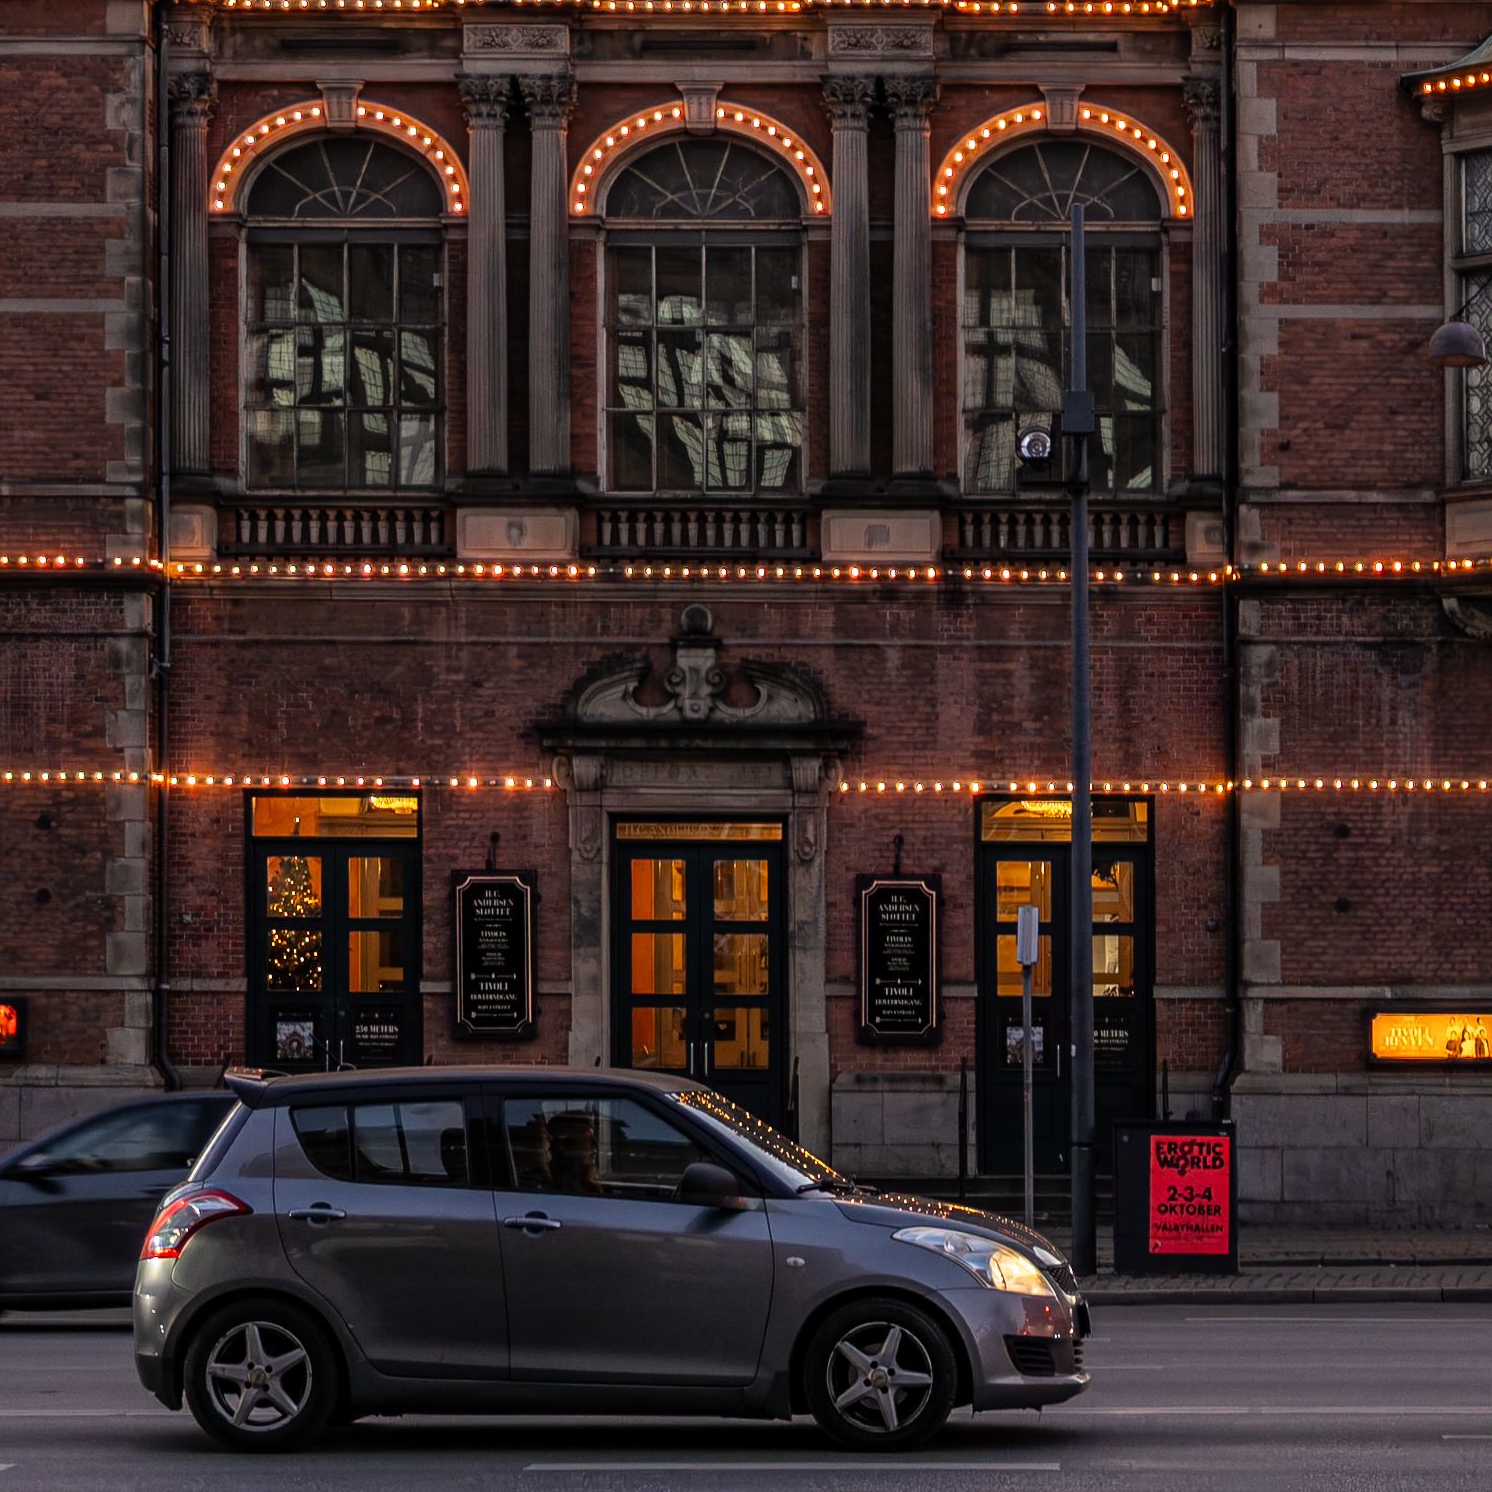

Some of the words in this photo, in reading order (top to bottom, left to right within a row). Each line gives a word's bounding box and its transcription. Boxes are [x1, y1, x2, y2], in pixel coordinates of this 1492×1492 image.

[473, 899, 514, 907] ANDERSEN
[879, 904, 920, 912] ANDERSEN
[479, 982, 509, 991] TIVOLI
[884, 987, 914, 996] TIVOLI
[1155, 1140, 1224, 1156] EROTIC
[1156, 1155, 1225, 1171] WORLD
[1167, 1185, 1213, 1202] 2-3-4
[1157, 1203, 1223, 1216] OKTOBER
[1155, 1222, 1225, 1233] VALBYHALLEN
